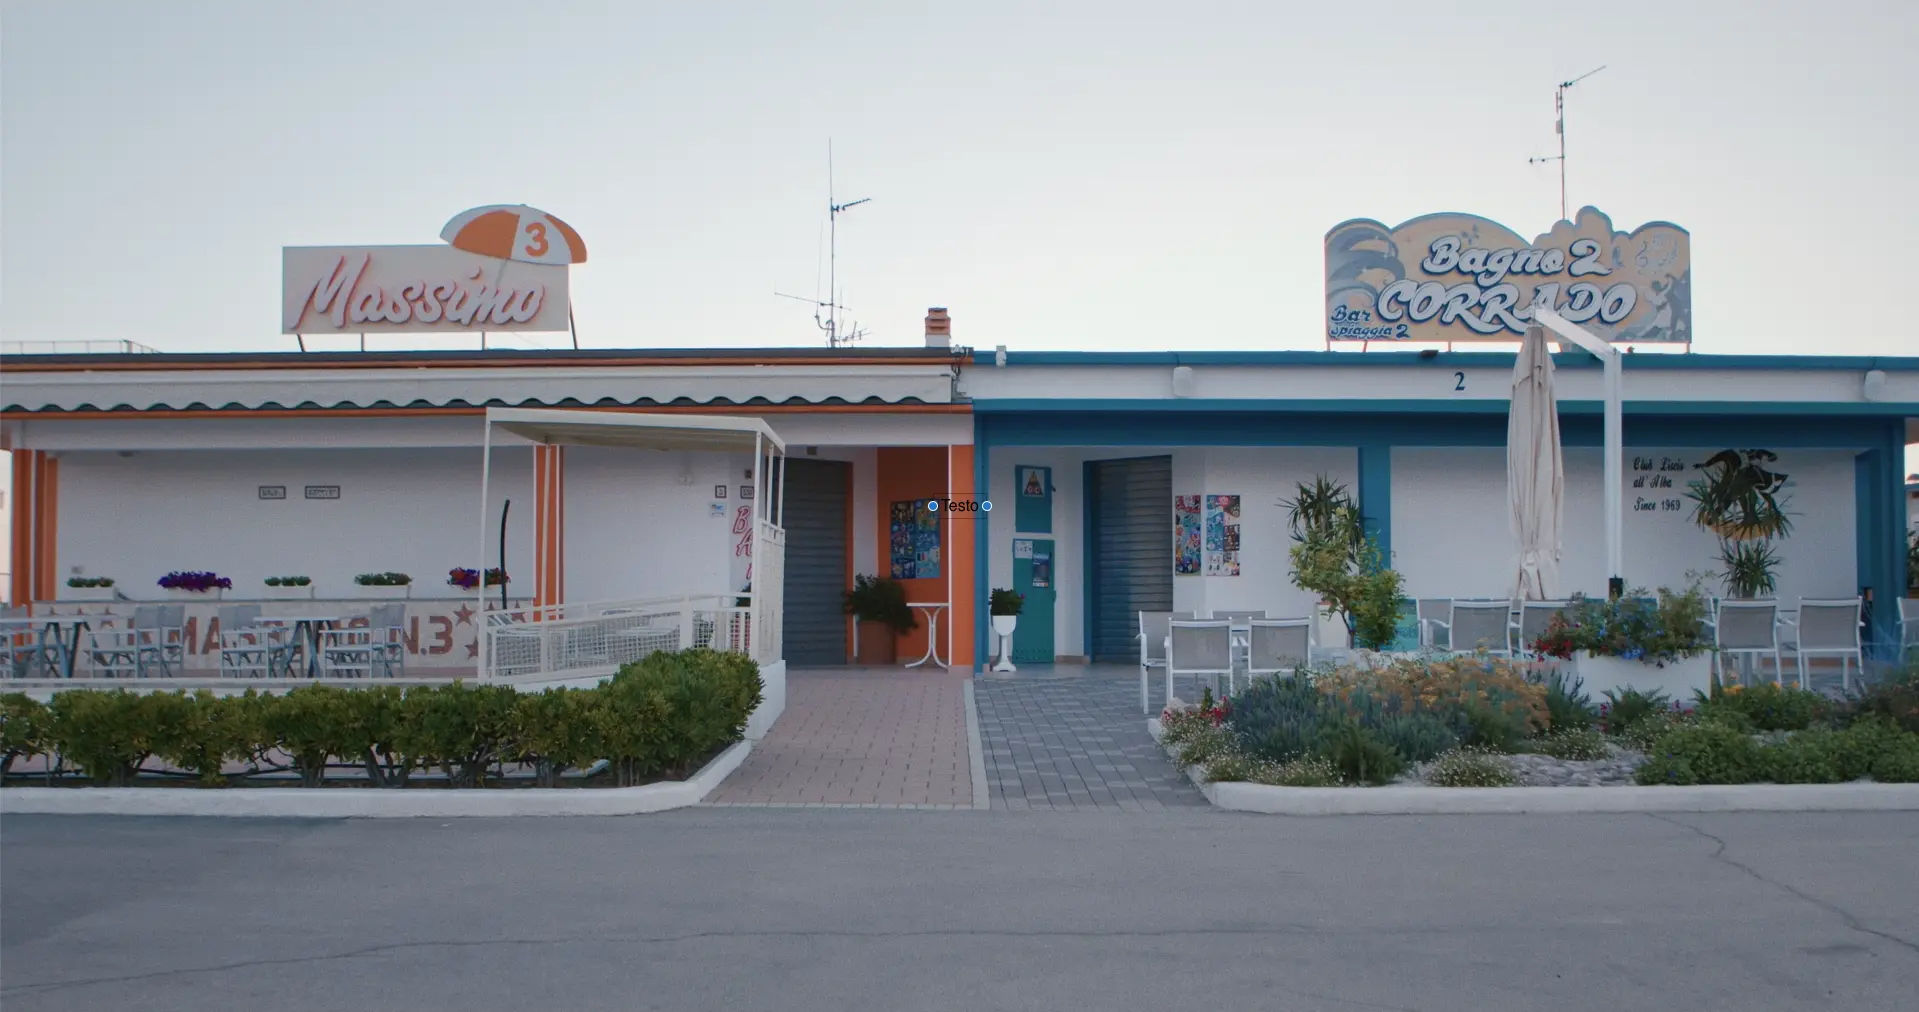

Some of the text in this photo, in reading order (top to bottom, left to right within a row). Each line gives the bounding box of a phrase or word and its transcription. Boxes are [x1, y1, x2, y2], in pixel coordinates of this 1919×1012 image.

[525, 222, 549, 257] 3
[1421, 235, 1613, 287] Bagno 2
[290, 252, 547, 330] Massimo
[1331, 304, 1371, 321] Bar
[1376, 279, 1638, 336] CORRADO
[1396, 324, 1411, 338] 2
[1454, 371, 1466, 391] 2
[1633, 457, 1653, 472] Club
[1650, 474, 1672, 488] Alba
[1634, 497, 1681, 511] Since 1969
